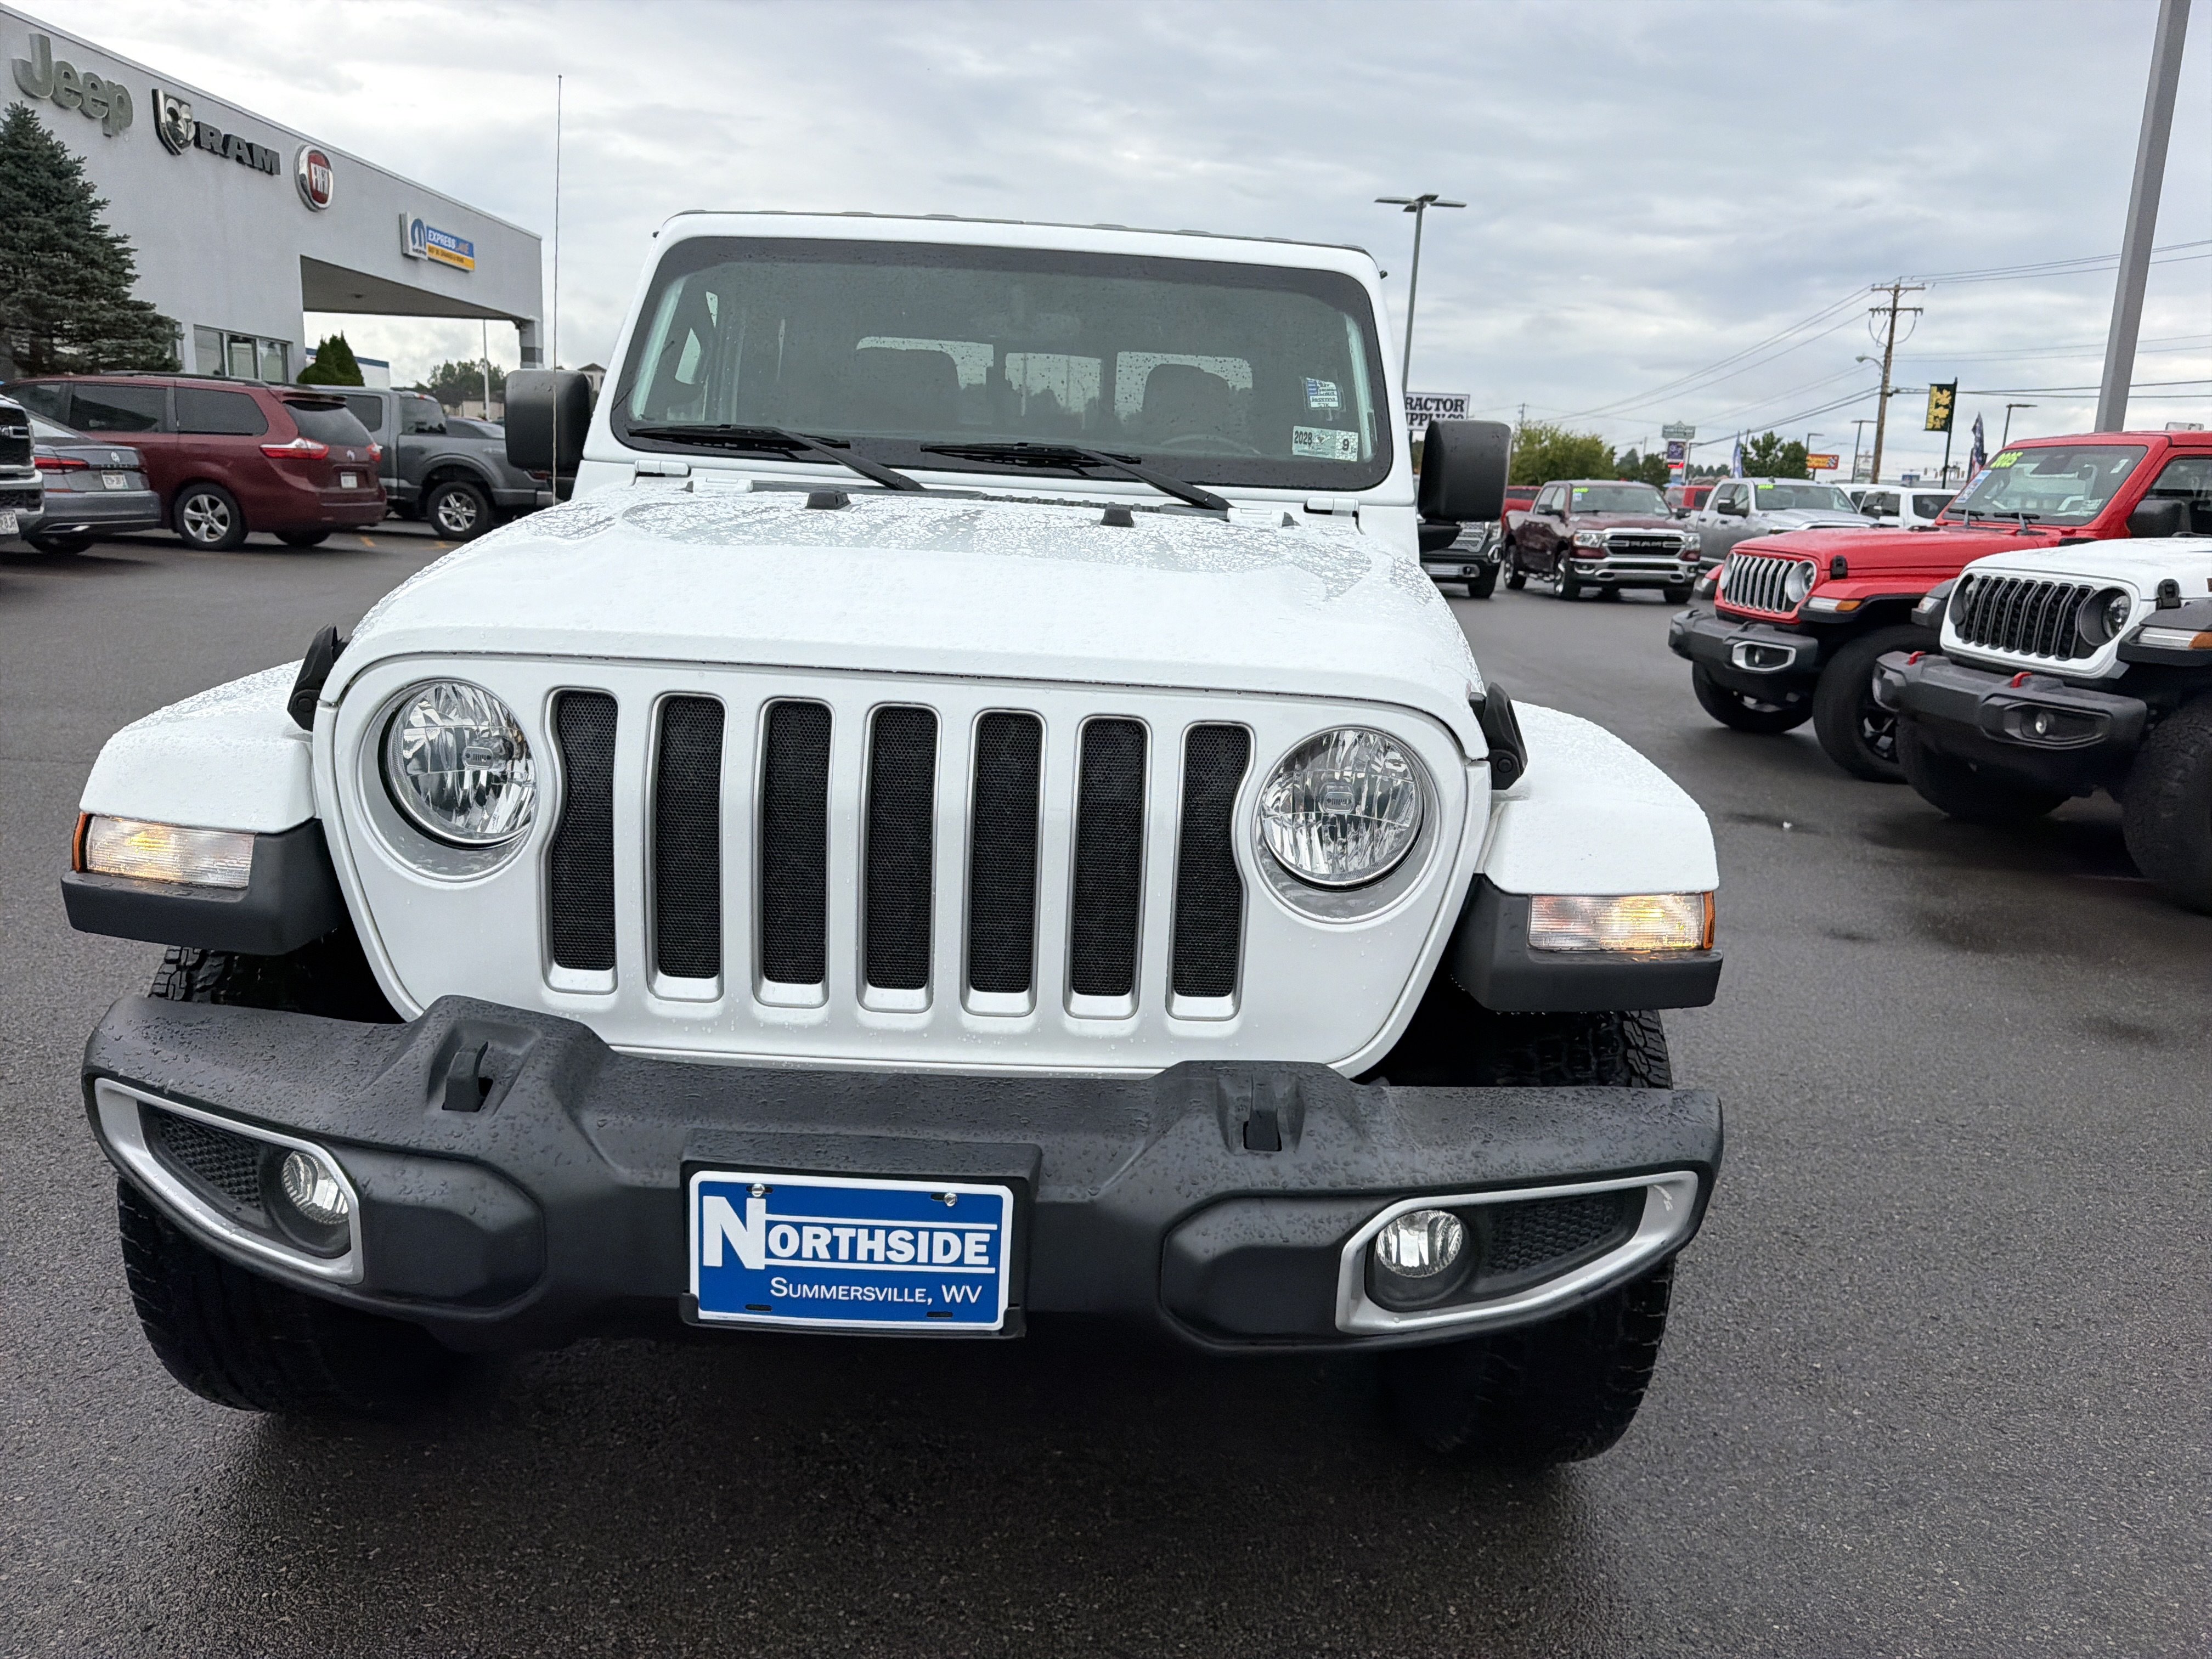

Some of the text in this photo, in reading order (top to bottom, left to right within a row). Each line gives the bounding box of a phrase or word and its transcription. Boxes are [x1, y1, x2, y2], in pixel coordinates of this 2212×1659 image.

[11, 33, 133, 138] Jeep
[194, 121, 281, 176] RAM
[428, 229, 456, 249] EXPRESS
[1405, 397, 1464, 412] RACTOR
[1294, 430, 1350, 451] 2028 9
[941, 1284, 983, 1303] WV
